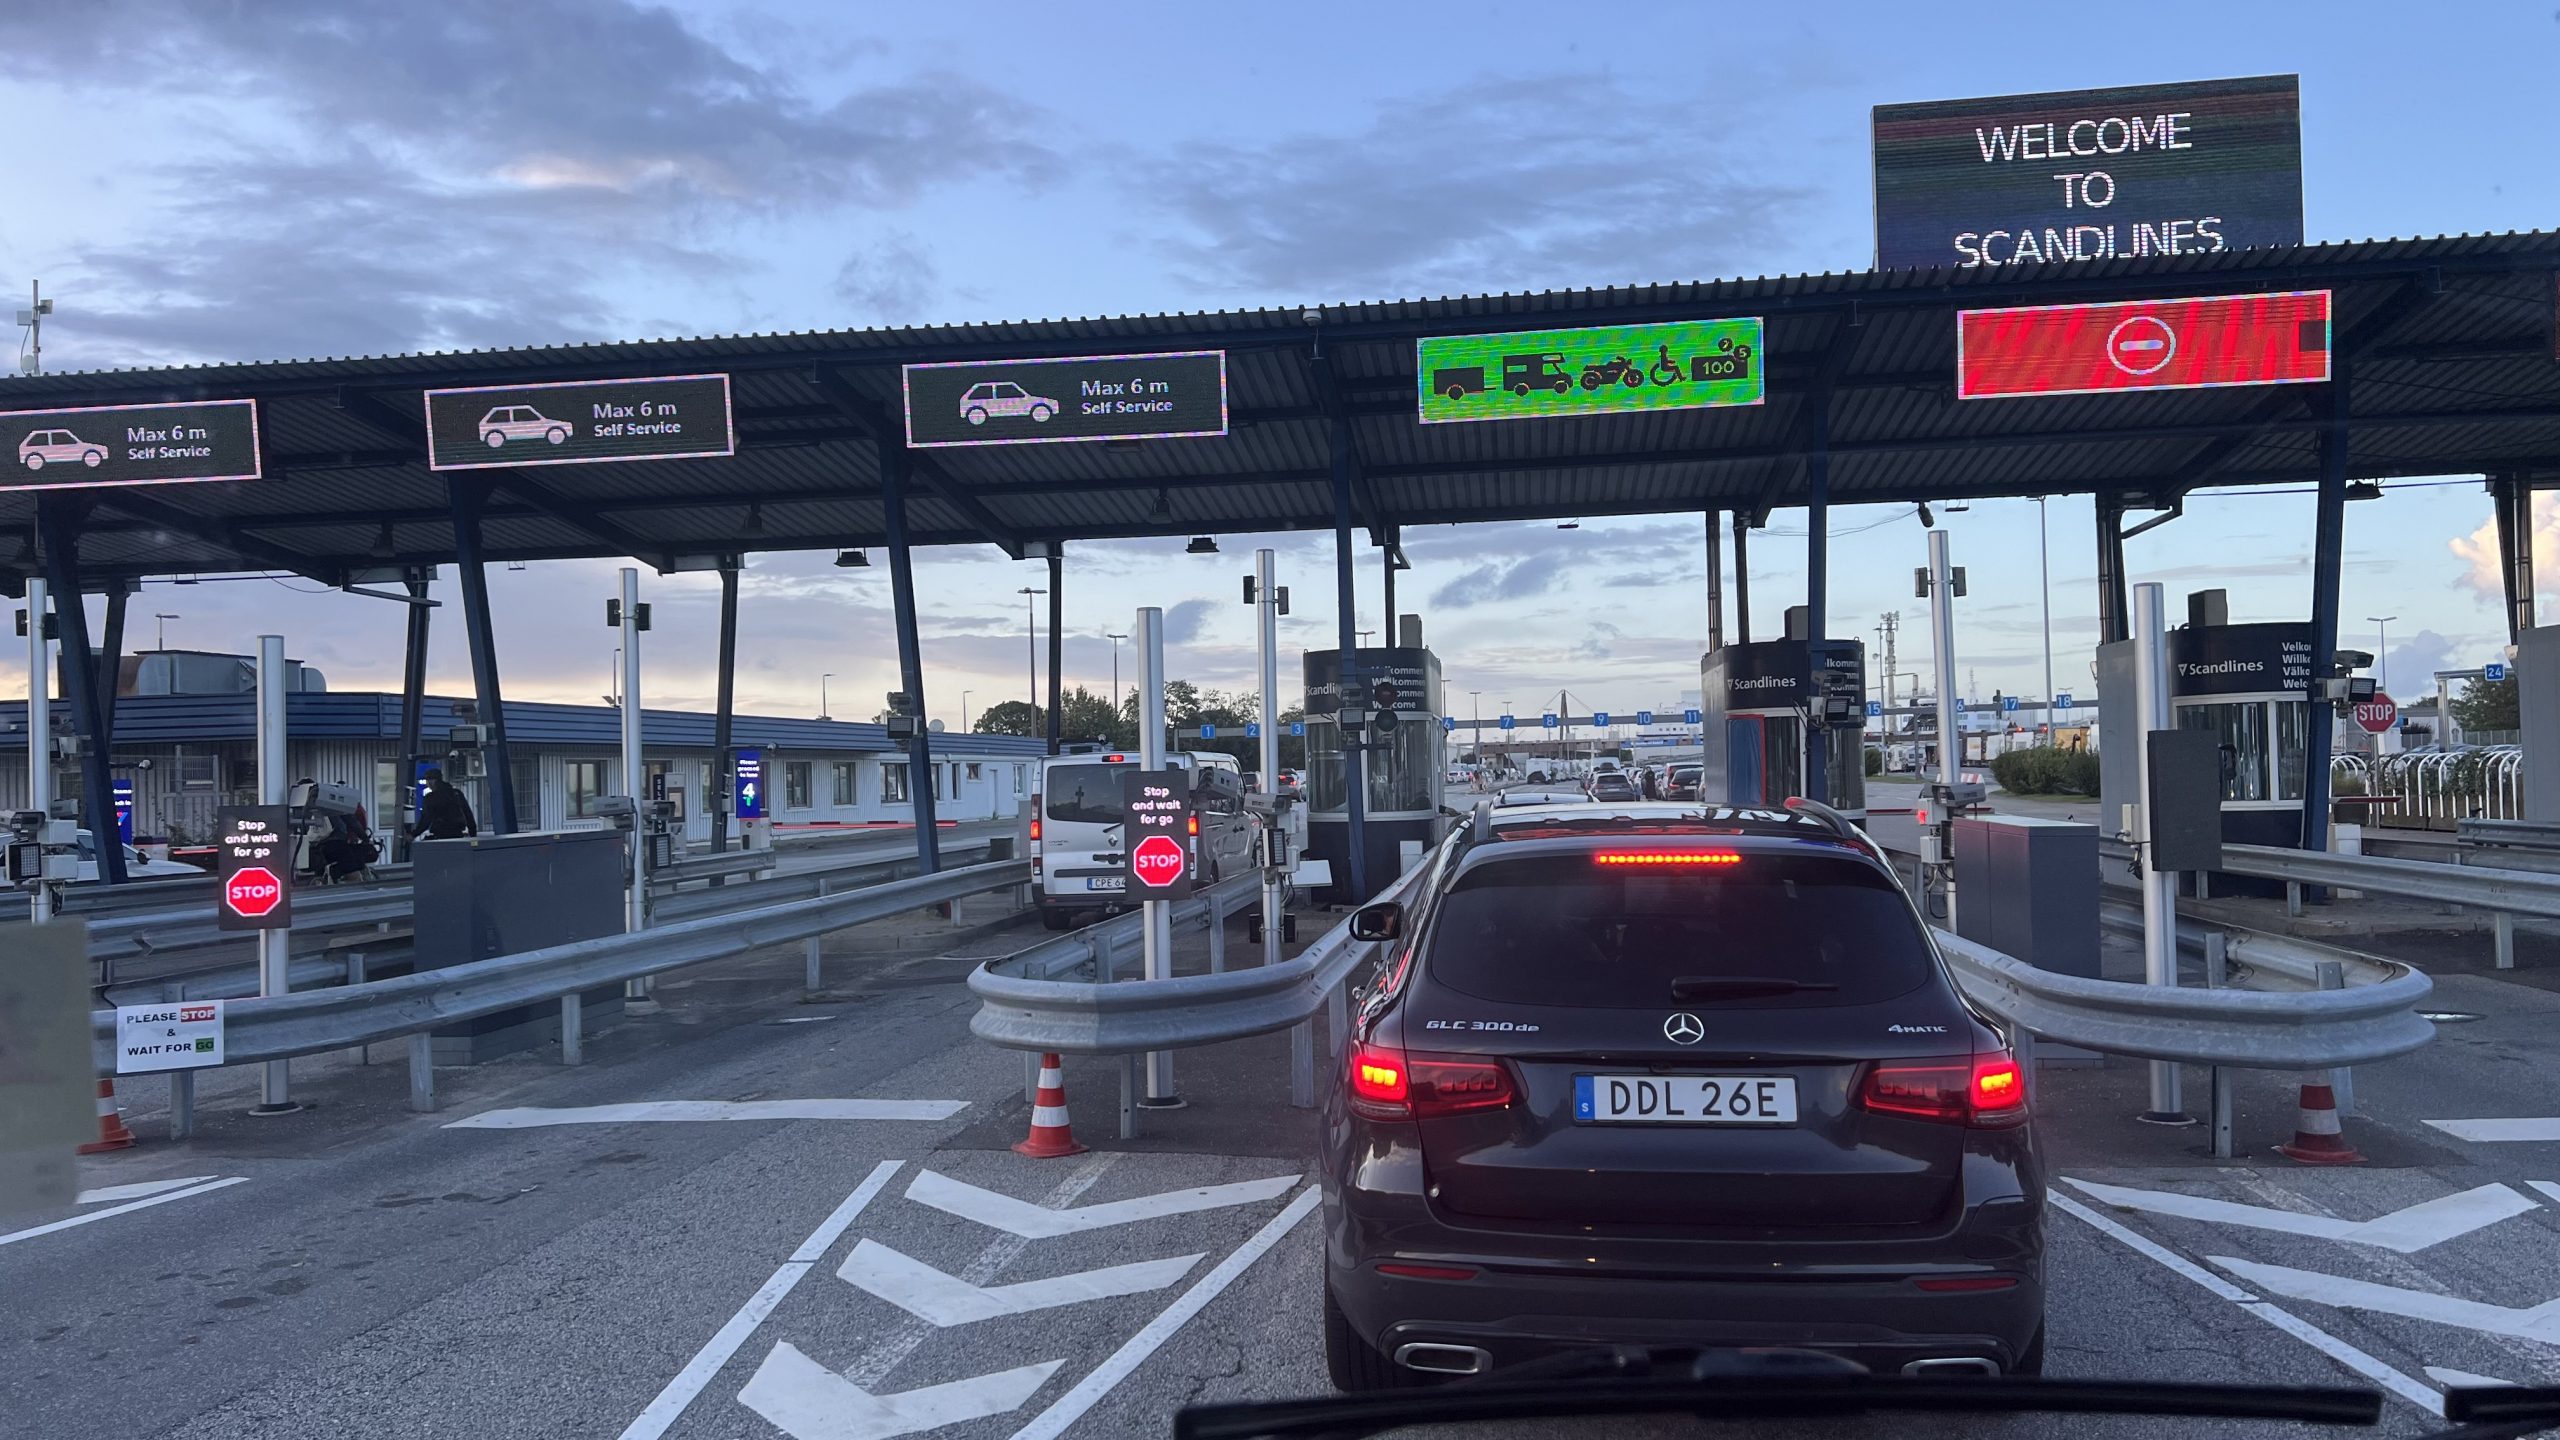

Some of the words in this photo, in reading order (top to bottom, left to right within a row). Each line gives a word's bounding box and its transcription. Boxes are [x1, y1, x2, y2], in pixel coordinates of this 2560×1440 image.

[1975, 112, 2193, 163] WELCOME
[2053, 171, 2115, 209] TO
[1953, 217, 2224, 268] SCANDLINES
[1739, 347, 1747, 358] 5
[1703, 360, 1735, 375] 100
[1081, 380, 1125, 396] Max
[1131, 378, 1143, 394] 6
[1149, 381, 1169, 394] m
[593, 403, 634, 418] Max
[640, 401, 652, 416] 6
[658, 403, 677, 416] m
[1081, 401, 1112, 415] Self
[1116, 400, 1173, 413] Service
[127, 427, 166, 442] Max
[172, 425, 183, 440] 6
[188, 428, 207, 440] m
[594, 423, 623, 437] Self
[626, 421, 681, 435] Service
[128, 447, 156, 460] Self
[160, 446, 211, 458] Service
[2282, 641, 2311, 651] Velko
[2190, 660, 2264, 675] Scandlines
[2282, 666, 2310, 676] Välko
[2488, 667, 2502, 677] 24
[1734, 676, 1796, 690] Scandlines
[2283, 678, 2309, 689] Welc
[1306, 682, 1336, 697] Scandli
[1372, 701, 1416, 710] Wcome
[2004, 700, 2017, 710] 17
[2058, 696, 2071, 707] 18
[1867, 703, 1881, 715] 15
[2359, 704, 2393, 721] STOP
[1443, 718, 1450, 729] 6
[1503, 717, 1510, 727] 7
[1546, 716, 1554, 726] 8
[1598, 714, 1605, 725] 9
[1638, 712, 1651, 724] 10
[1687, 712, 1697, 723] 11
[1249, 725, 1256, 736] 2
[1294, 723, 1301, 734] 3
[742, 783, 755, 799] 4
[1143, 786, 1170, 798] Stop
[1132, 799, 1154, 811] and
[1156, 800, 1181, 810] wait
[237, 820, 266, 831] Stop
[1140, 813, 1156, 824] for
[1158, 815, 1173, 826] go
[224, 833, 249, 844] and
[250, 833, 278, 843] wait
[233, 846, 251, 857] for
[254, 847, 270, 858] go
[1139, 855, 1179, 869] STOP
[1095, 879, 1113, 888] CPE
[231, 885, 276, 900] STOP
[126, 1012, 177, 1024] PLEASE
[181, 1009, 215, 1020] STOP
[1426, 1020, 1466, 1030] GLC
[1888, 1024, 1948, 1033] 4MATIC
[166, 1028, 176, 1036] &
[127, 1045, 162, 1056] WAIT
[165, 1043, 192, 1053] FOR
[195, 1041, 214, 1050] GO
[1610, 1080, 1685, 1116] DDL
[1701, 1081, 1778, 1117] 26E
[1580, 1103, 1589, 1113] S
